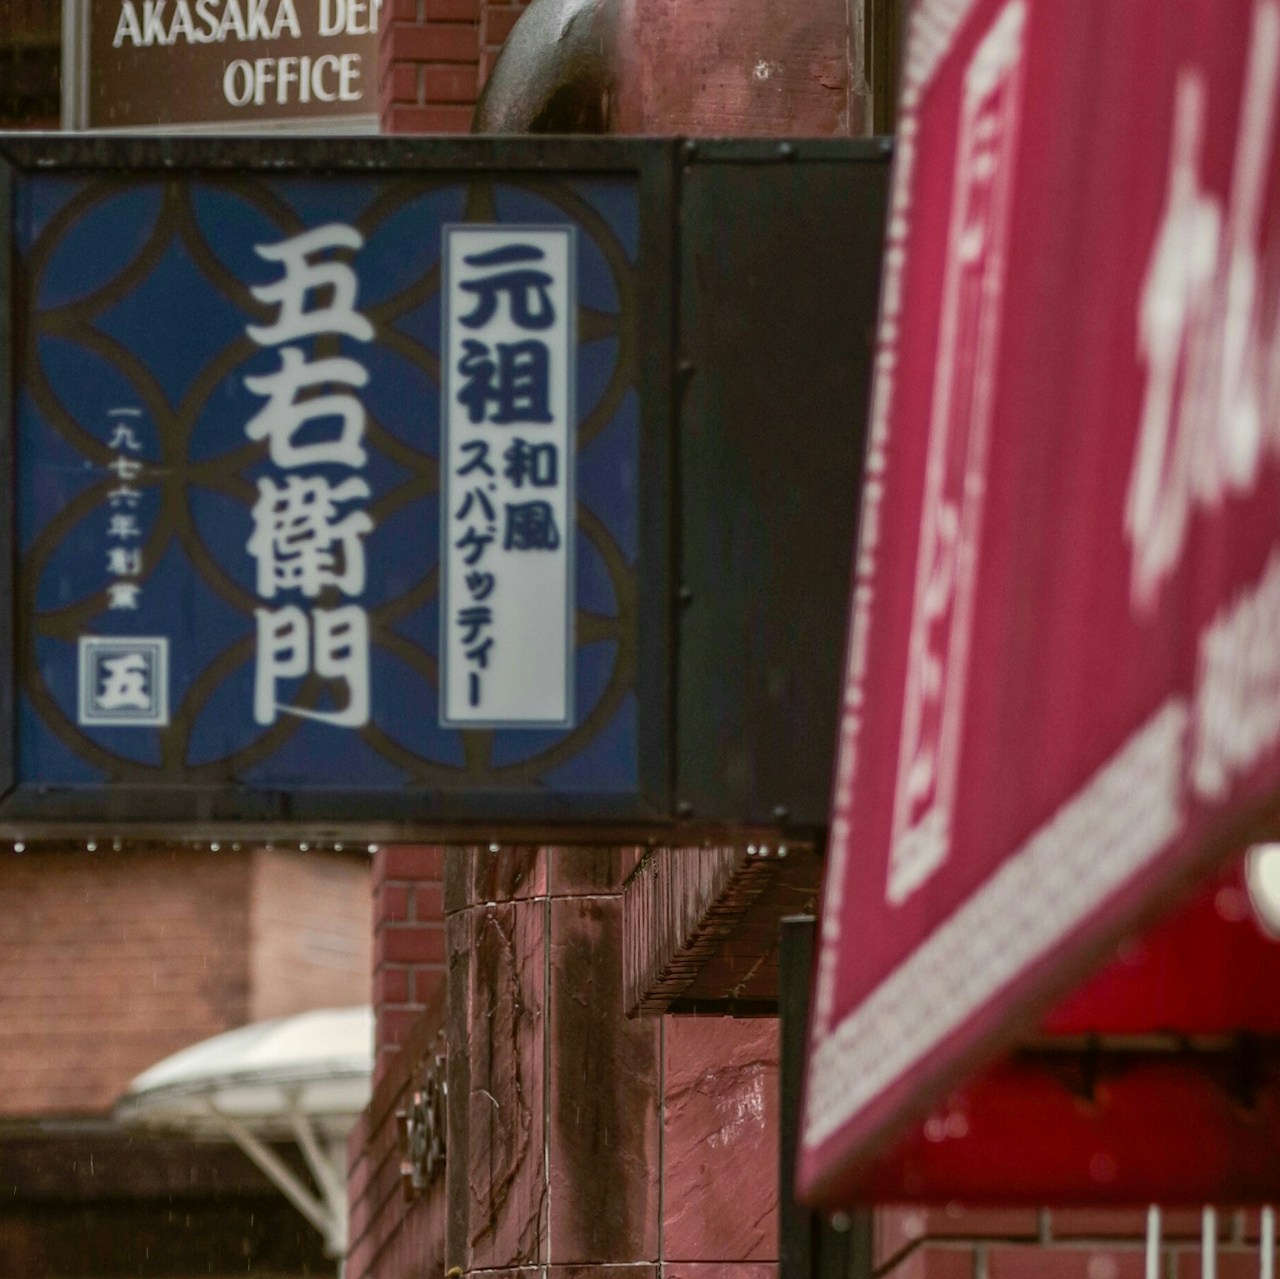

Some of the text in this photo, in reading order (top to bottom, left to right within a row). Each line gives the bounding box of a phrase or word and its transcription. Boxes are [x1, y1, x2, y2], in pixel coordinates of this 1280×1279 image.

[113, 0, 302, 47] AKASAKA
[223, 53, 363, 107] OFFICE
[457, 243, 556, 425] 元祖
[244, 222, 376, 728] 五右衛門
[503, 436, 560, 552] 和風
[455, 438, 497, 708] スパゲッティー
